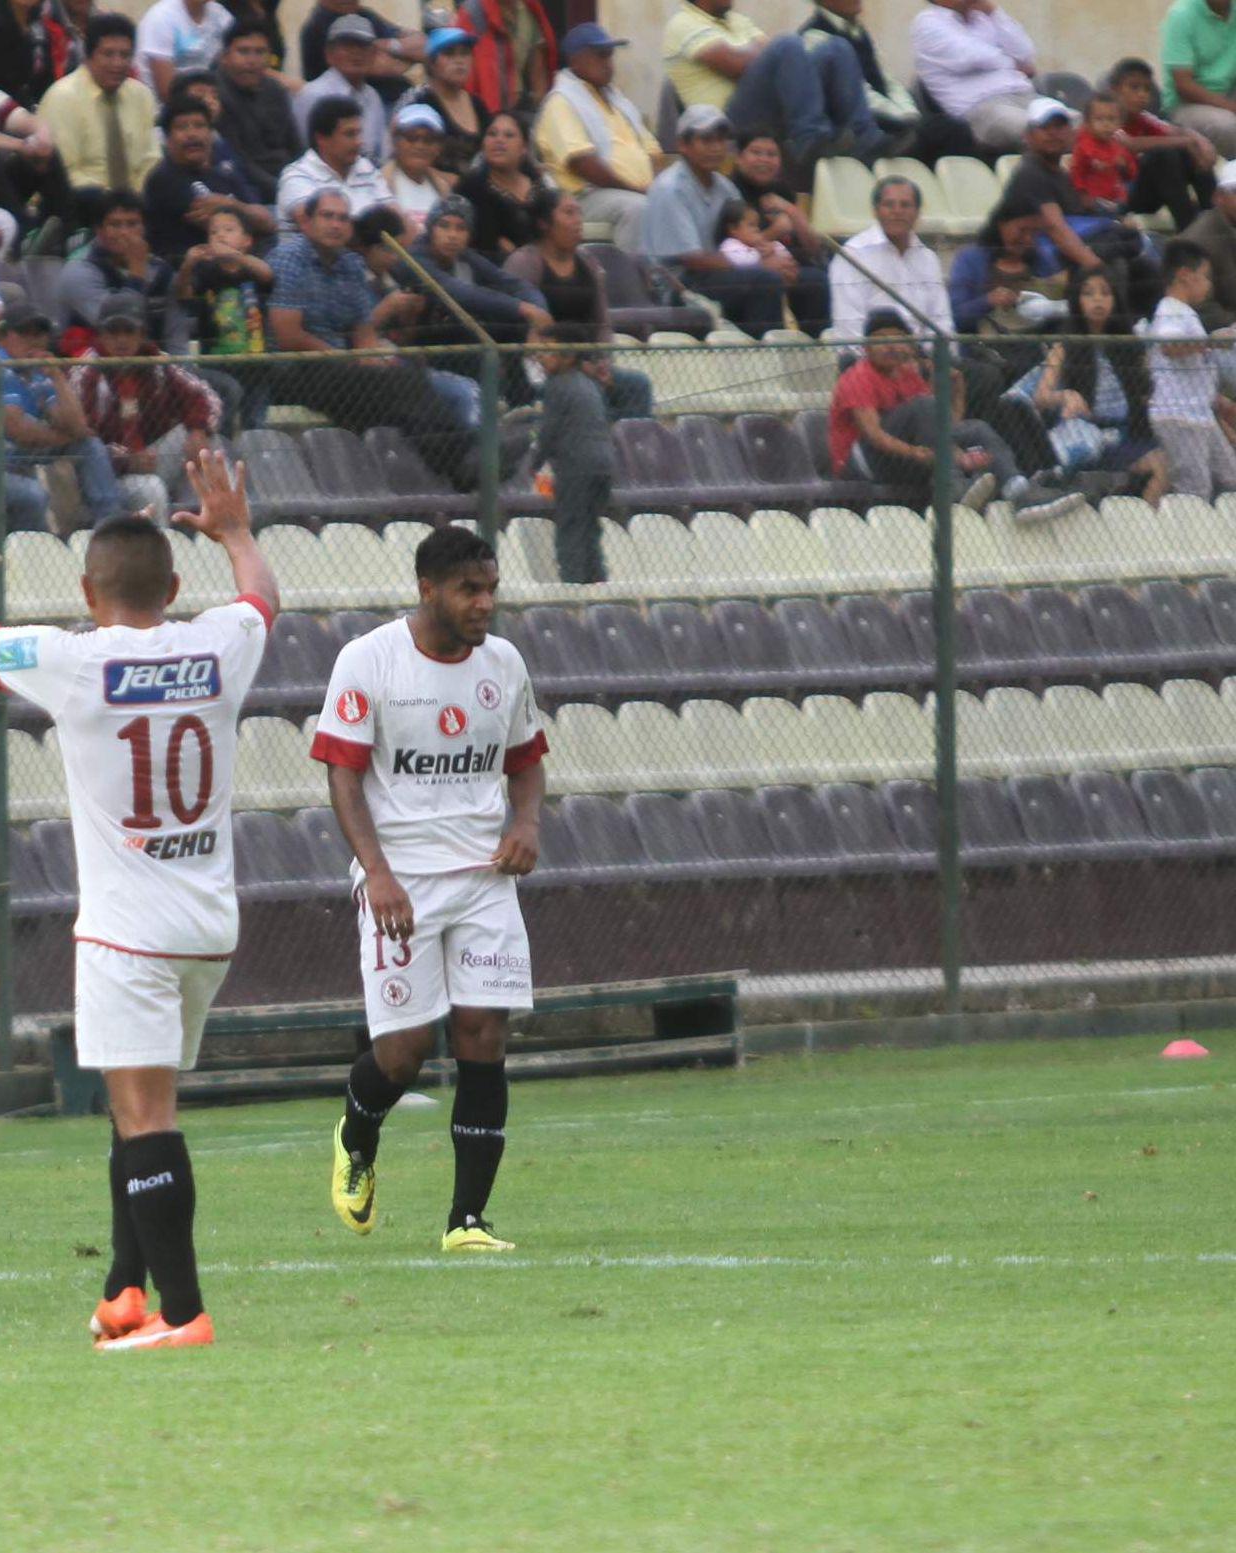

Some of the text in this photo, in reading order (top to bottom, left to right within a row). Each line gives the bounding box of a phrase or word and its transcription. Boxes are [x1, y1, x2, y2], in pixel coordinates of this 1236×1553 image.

[117, 714, 213, 829] 10
[393, 744, 499, 775] Kendall
[144, 831, 217, 860] ECHO
